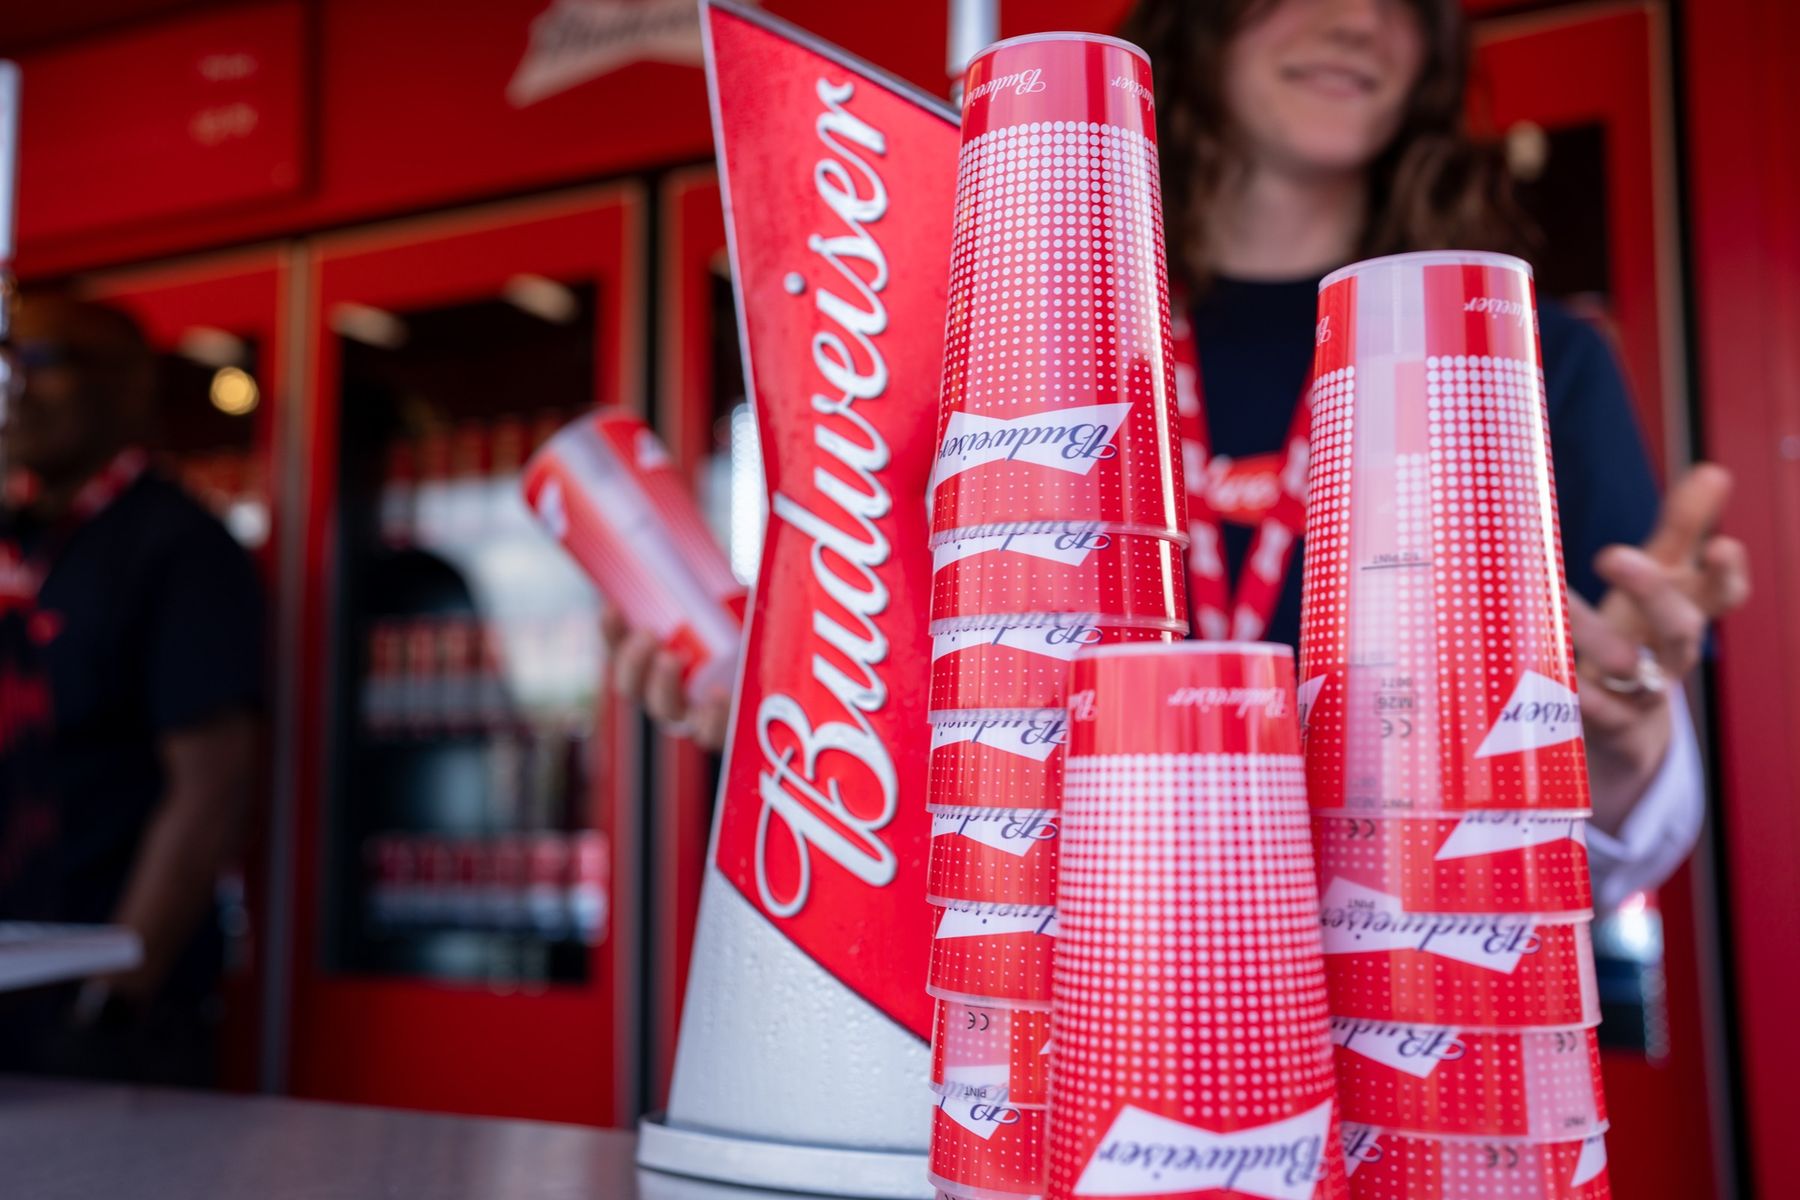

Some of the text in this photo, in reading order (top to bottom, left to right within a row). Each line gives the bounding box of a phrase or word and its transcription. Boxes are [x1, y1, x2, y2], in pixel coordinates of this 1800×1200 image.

[938, 423, 1118, 461] Budweiser
[756, 78, 897, 917] Budweiser
[964, 1086, 987, 1098] PINT
[1098, 1134, 1328, 1192] Budweiser
